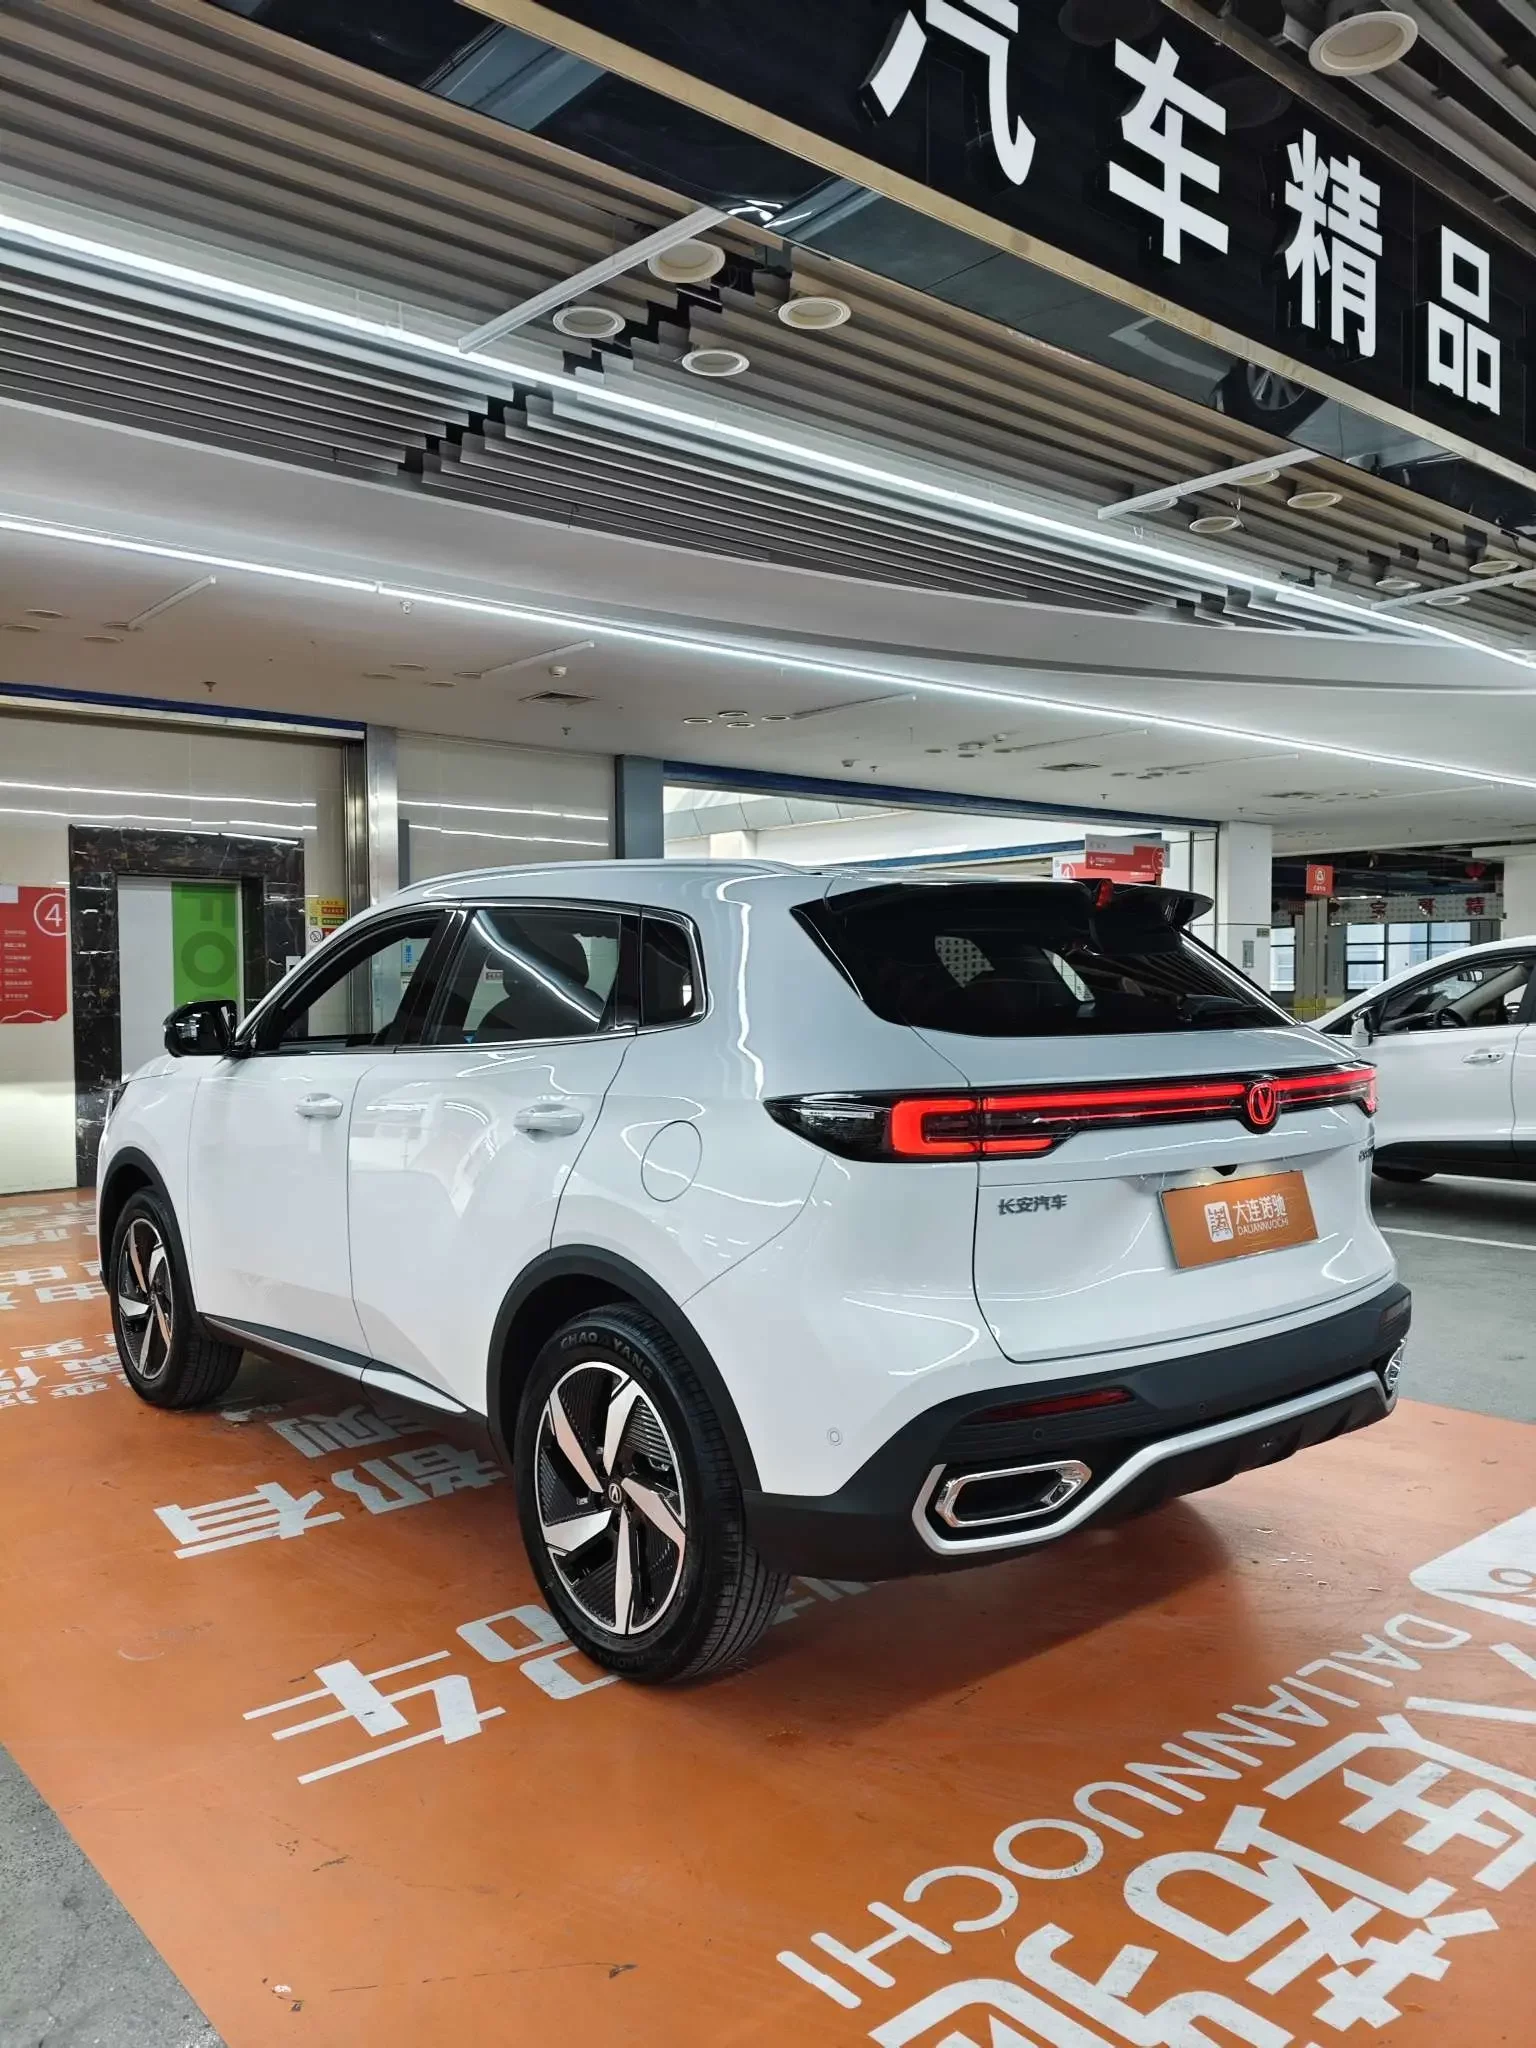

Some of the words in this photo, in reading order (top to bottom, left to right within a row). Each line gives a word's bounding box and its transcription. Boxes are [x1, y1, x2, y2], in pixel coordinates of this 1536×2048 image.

[860, 0, 1501, 416] 汽车精品
[44, 903, 63, 928] 4
[180, 883, 238, 1001] FO
[998, 1193, 1068, 1216] 长安汽车
[1232, 1193, 1287, 1225] 大连诺驰
[1237, 1217, 1290, 1237] DALIANNUOCHI
[561, 1331, 599, 1349] CHAO
[614, 1337, 654, 1379] YANG
[153, 1444, 508, 1559] 都有
[776, 1613, 1473, 2009] DALIANNUOCHI
